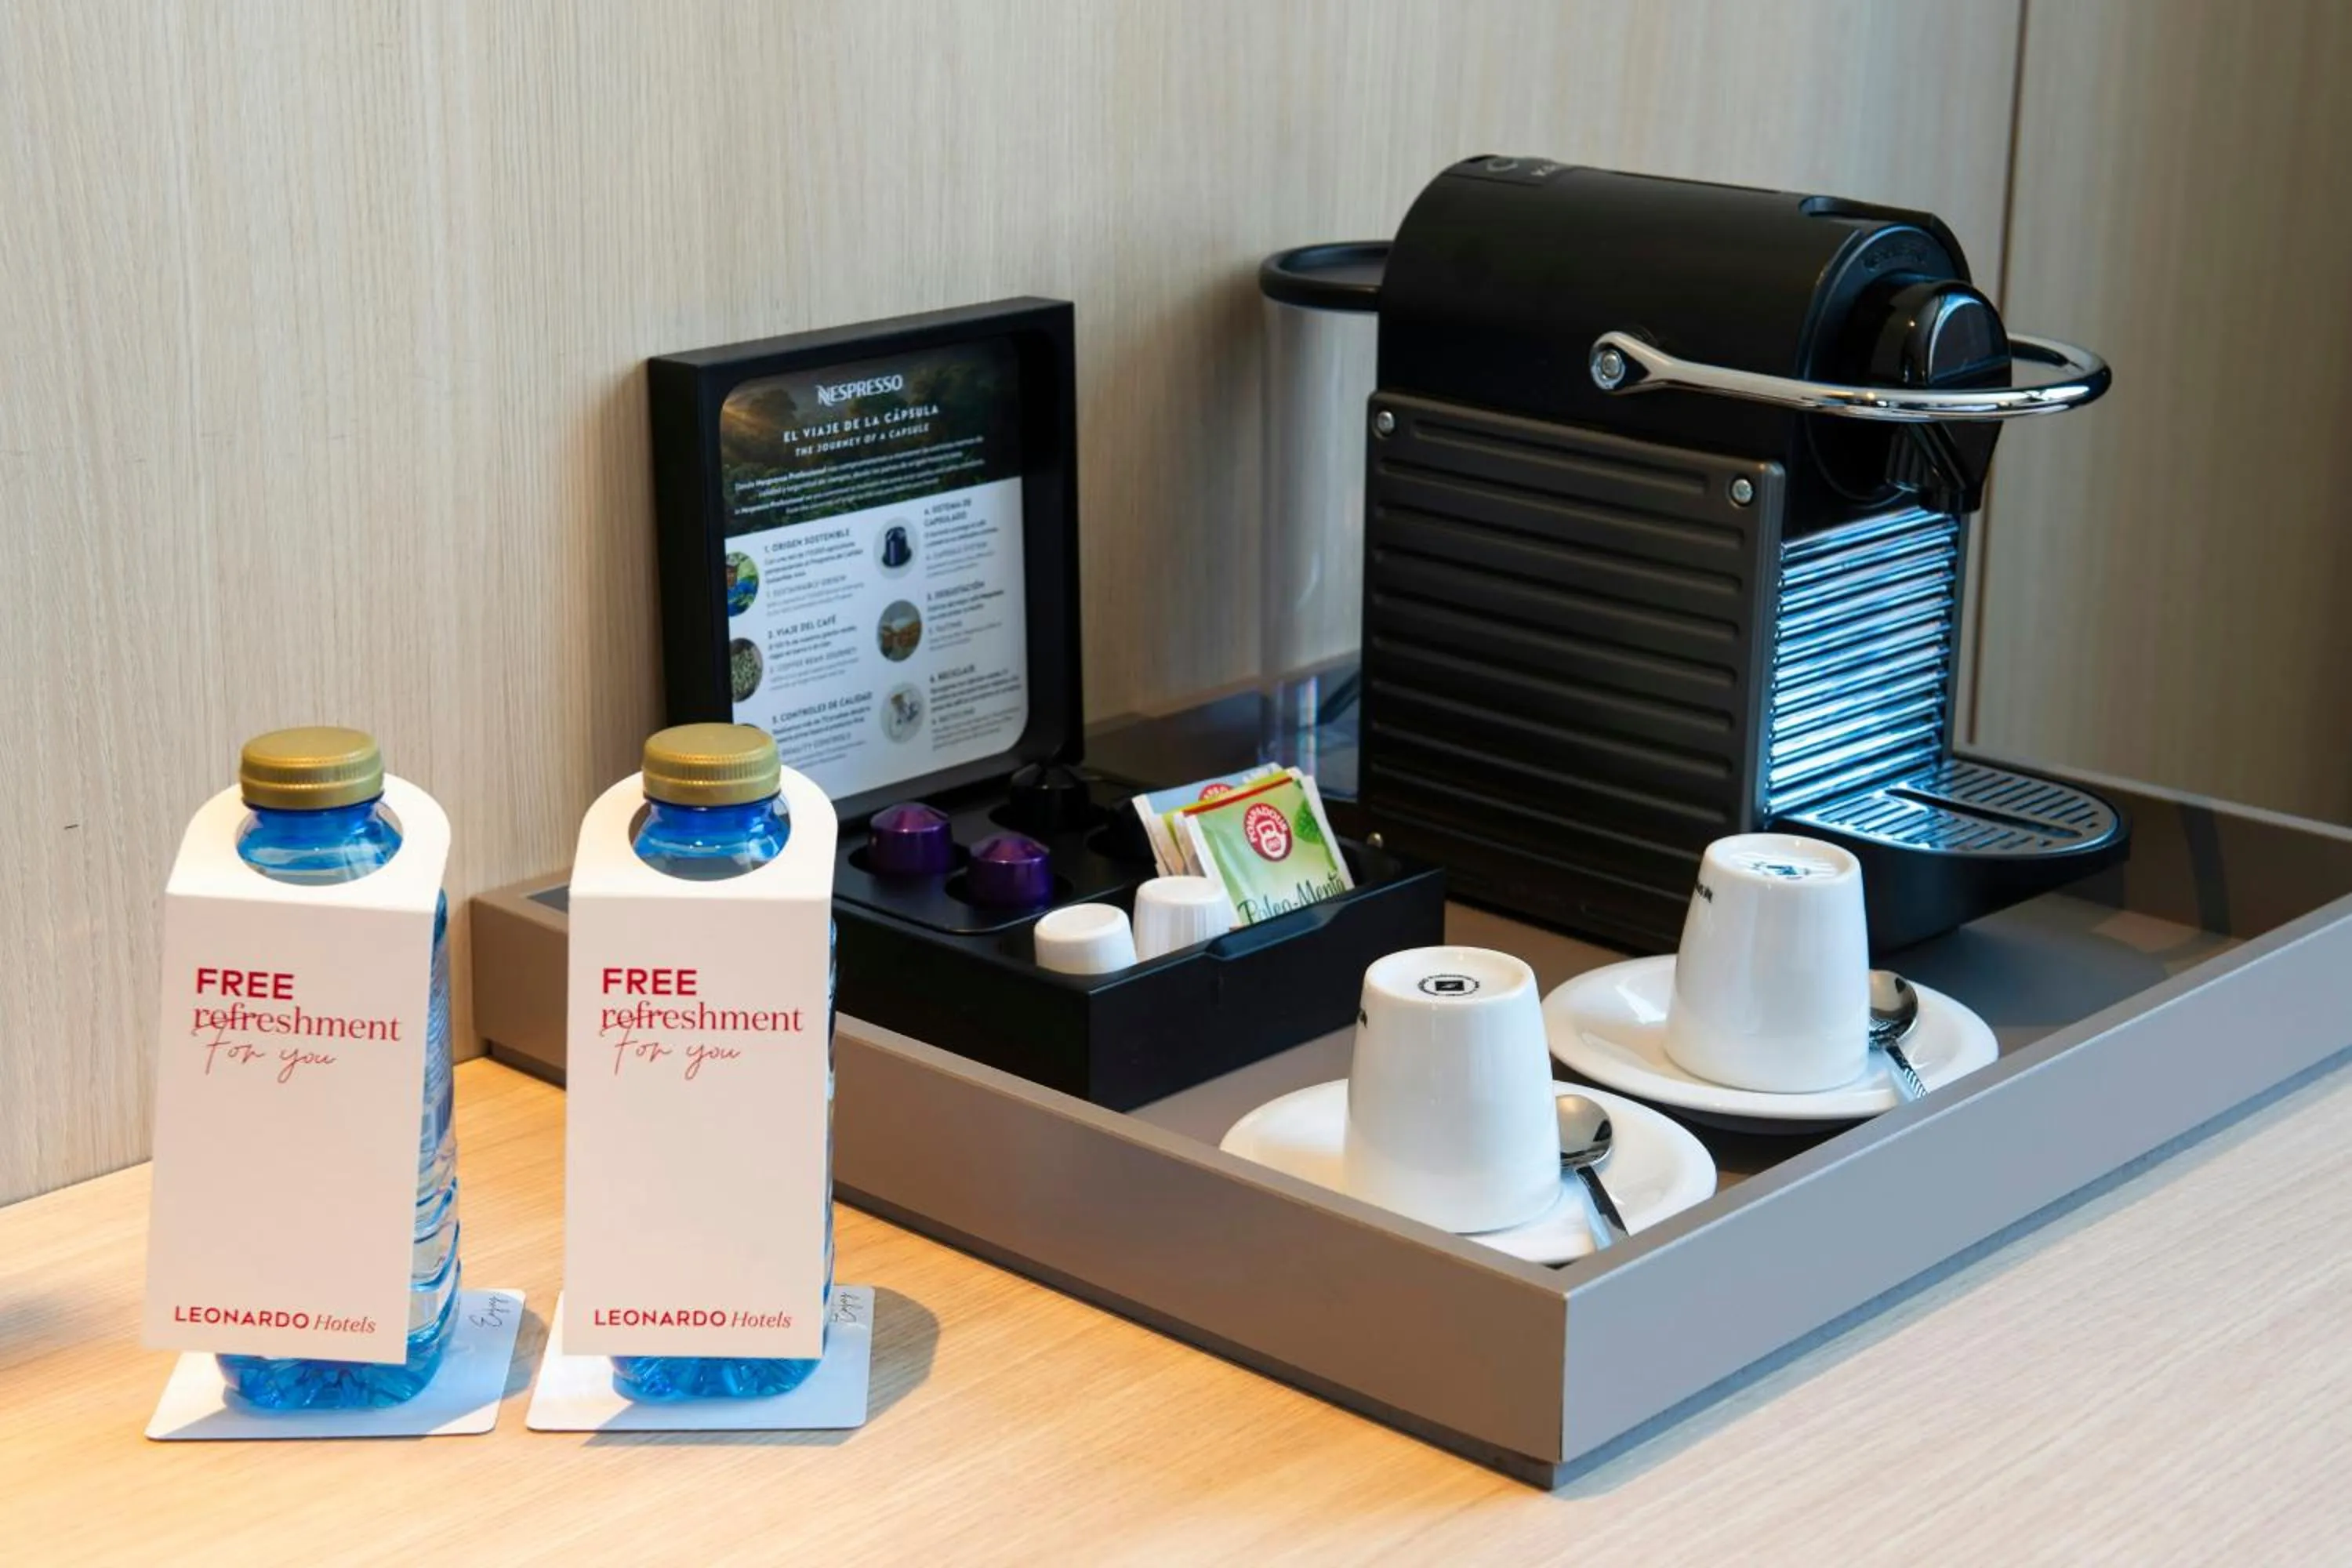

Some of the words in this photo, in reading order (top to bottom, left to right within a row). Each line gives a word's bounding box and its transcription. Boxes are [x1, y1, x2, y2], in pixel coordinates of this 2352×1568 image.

[816, 374, 903, 406] NESPRESSO
[784, 430, 798, 442] EL
[803, 422, 840, 437] VIAJE
[844, 417, 860, 430] DE
[864, 416, 880, 427] LA
[884, 405, 939, 424] CÁPSULA
[795, 445, 813, 457] THE
[816, 436, 861, 452] JOURNEY
[863, 432, 877, 445] OF
[888, 423, 930, 439] CAPSULE
[196, 967, 294, 1000] FREE
[602, 967, 698, 996] FREE
[194, 1002, 402, 1042] refreshment
[601, 1000, 804, 1031] refreshment
[191, 1017, 265, 1075] For
[277, 1048, 336, 1084] you
[599, 1017, 672, 1075] For
[684, 1043, 741, 1080] you
[175, 1305, 309, 1329] LEONARDO
[314, 1314, 376, 1334] Hotels
[594, 1308, 727, 1327] LEONARDO
[731, 1310, 792, 1329] Hotels
